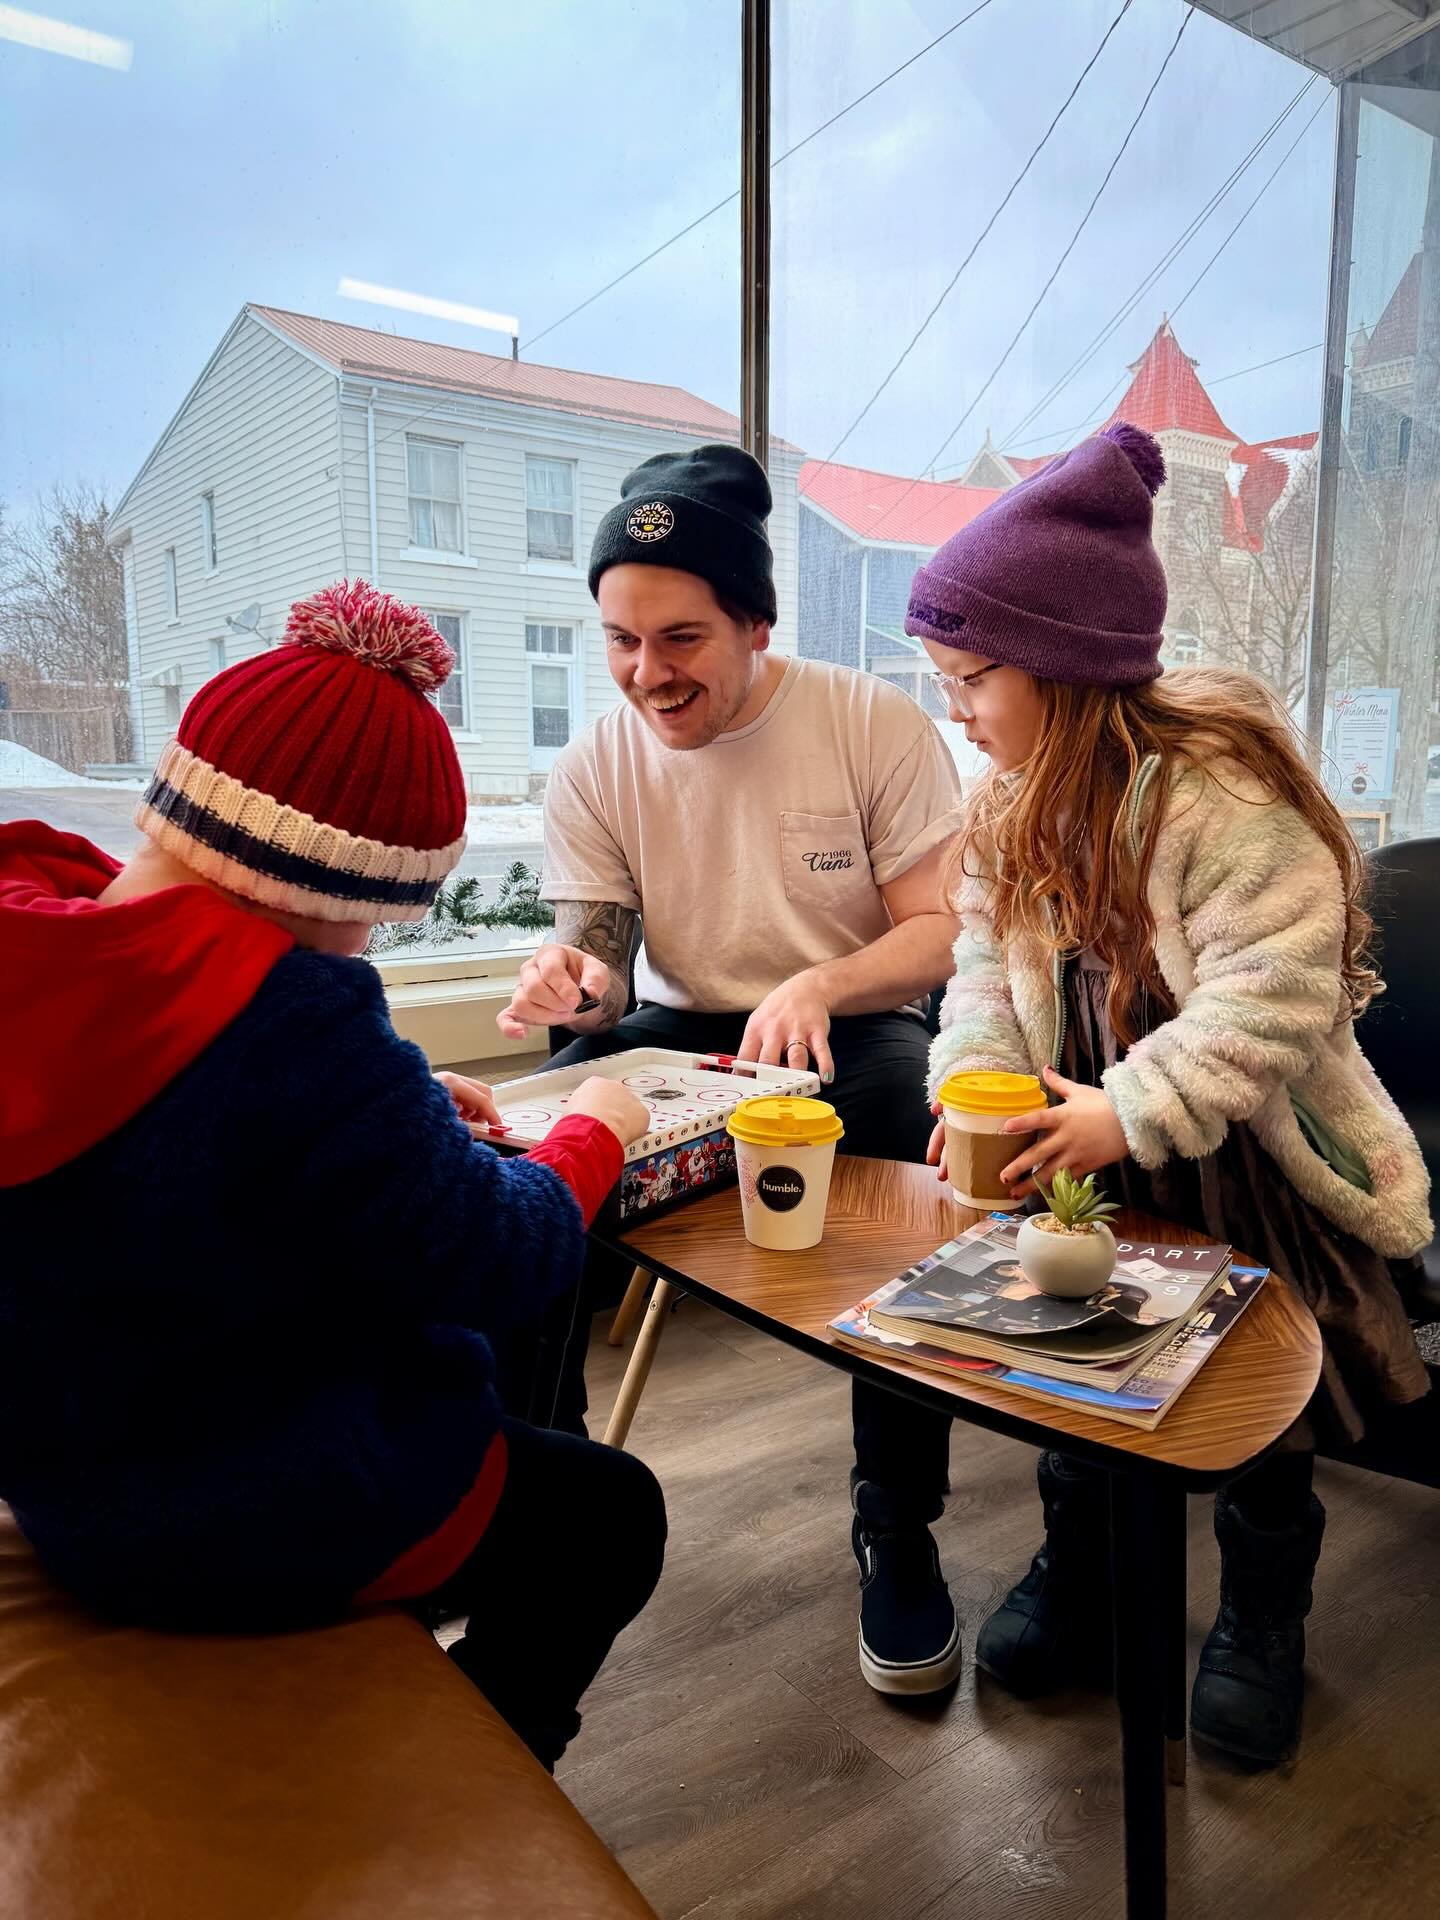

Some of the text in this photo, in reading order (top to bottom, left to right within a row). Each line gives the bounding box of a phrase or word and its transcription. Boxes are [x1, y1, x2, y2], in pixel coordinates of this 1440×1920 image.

[634, 503, 670, 517] DRINK
[630, 516, 671, 526] ETHICAL
[630, 526, 667, 540] COFFEE
[1367, 703, 1388, 718] Menu
[801, 852, 854, 872] Vans
[829, 850, 852, 860] 1966
[762, 1180, 802, 1193] humble.
